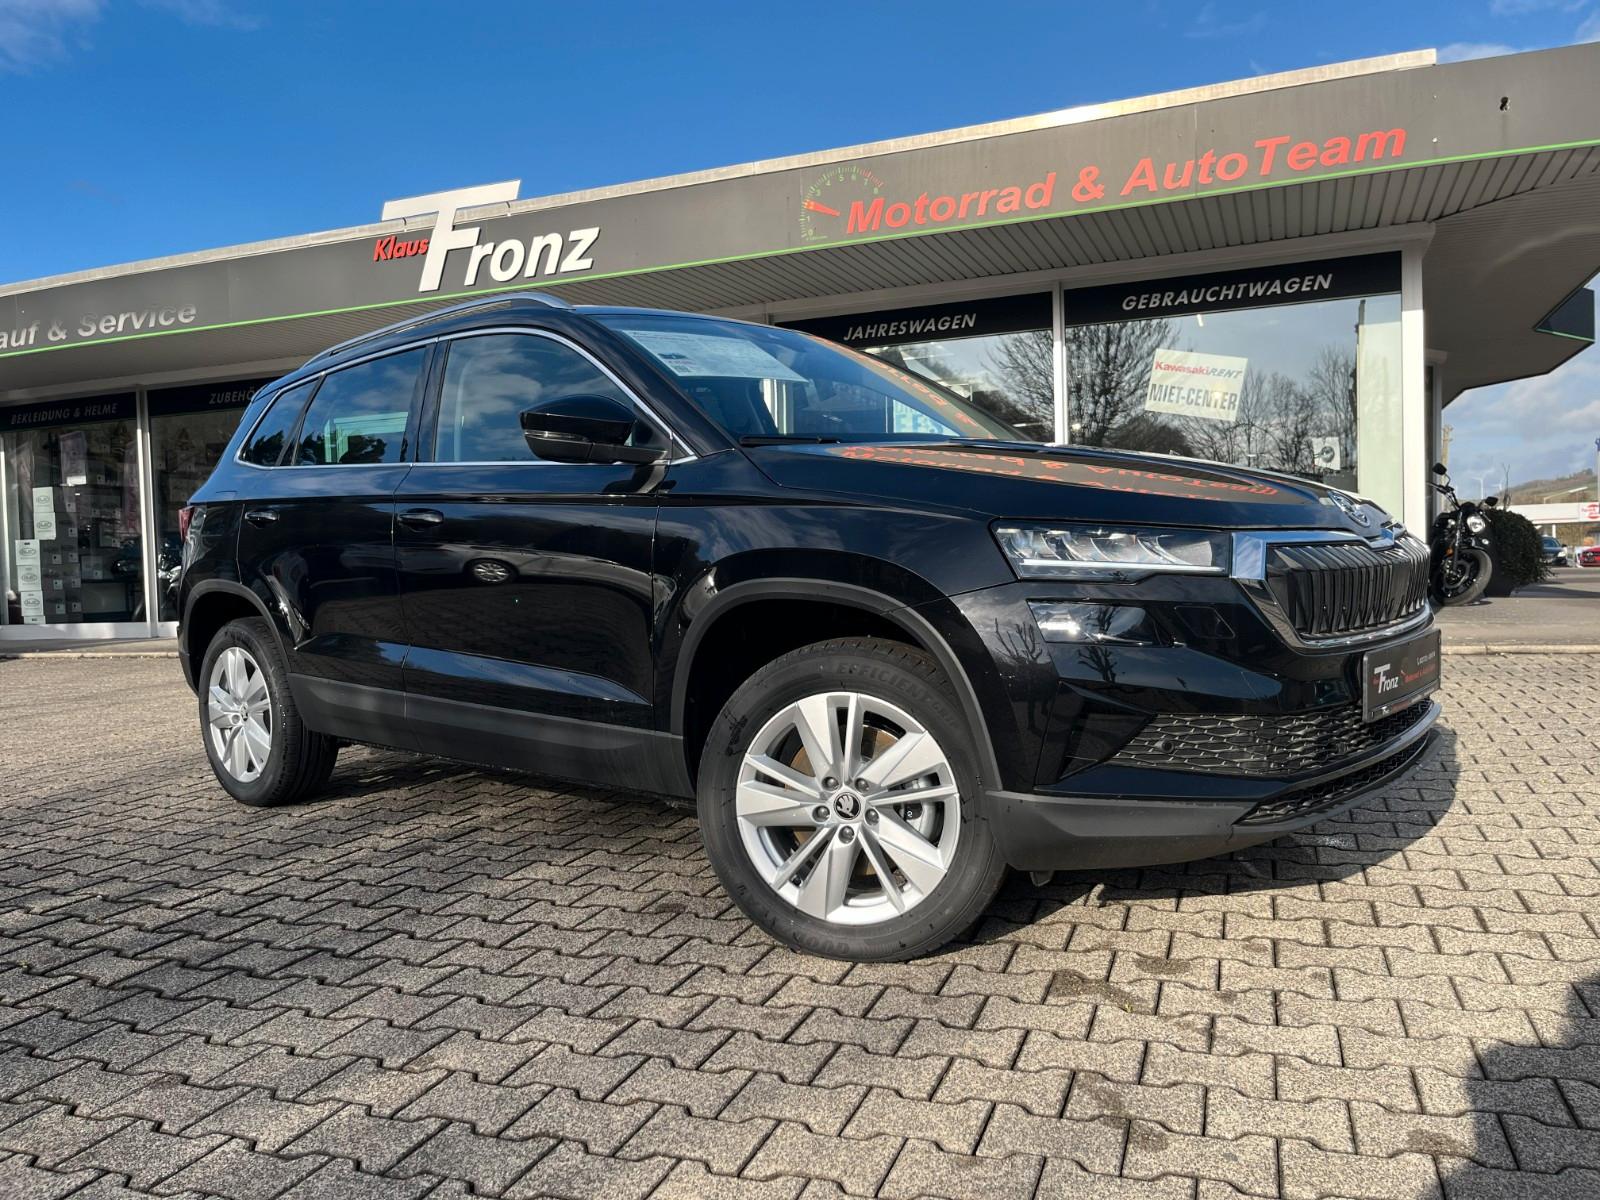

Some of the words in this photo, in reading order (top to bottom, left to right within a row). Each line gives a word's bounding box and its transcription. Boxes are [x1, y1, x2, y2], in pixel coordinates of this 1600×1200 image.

[847, 172, 1057, 234] Motorrad
[1071, 166, 1105, 202] &
[1119, 129, 1407, 195] AutoTeam
[373, 236, 429, 261] Klaus
[381, 180, 600, 292] Fronz
[1121, 273, 1333, 311] GEBRAUCHTWAGEN
[47, 320, 68, 342] &
[77, 303, 198, 338] Service
[843, 313, 977, 341] JAHRESWAGEN
[1148, 383, 1238, 411] MIET-CENTER
[11, 409, 70, 426] BEKLEIDUNG
[84, 402, 119, 417] HELME
[1374, 663, 1399, 694] Fronz
